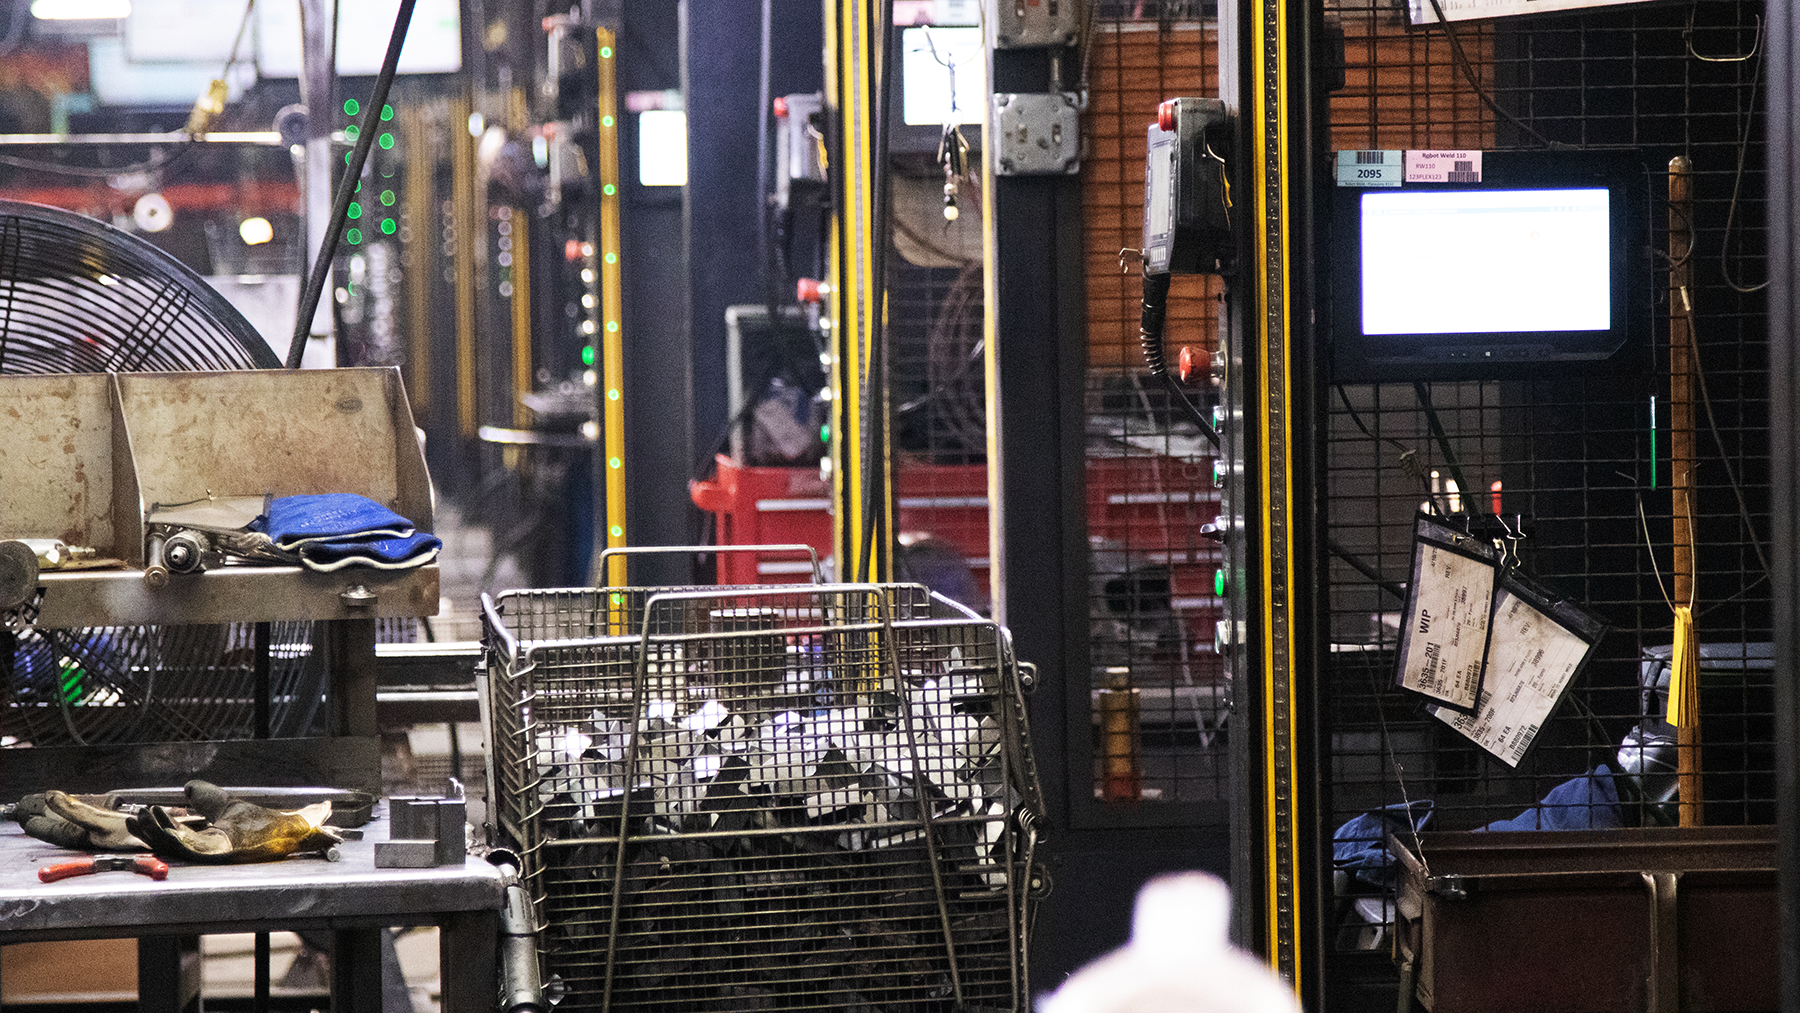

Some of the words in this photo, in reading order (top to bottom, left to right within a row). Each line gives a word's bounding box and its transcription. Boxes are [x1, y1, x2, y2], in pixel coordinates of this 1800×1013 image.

[1357, 169, 1382, 179] 2095
[1418, 608, 1431, 633] WIP
[1497, 734, 1506, 743] 64
[1502, 725, 1511, 735] EA
